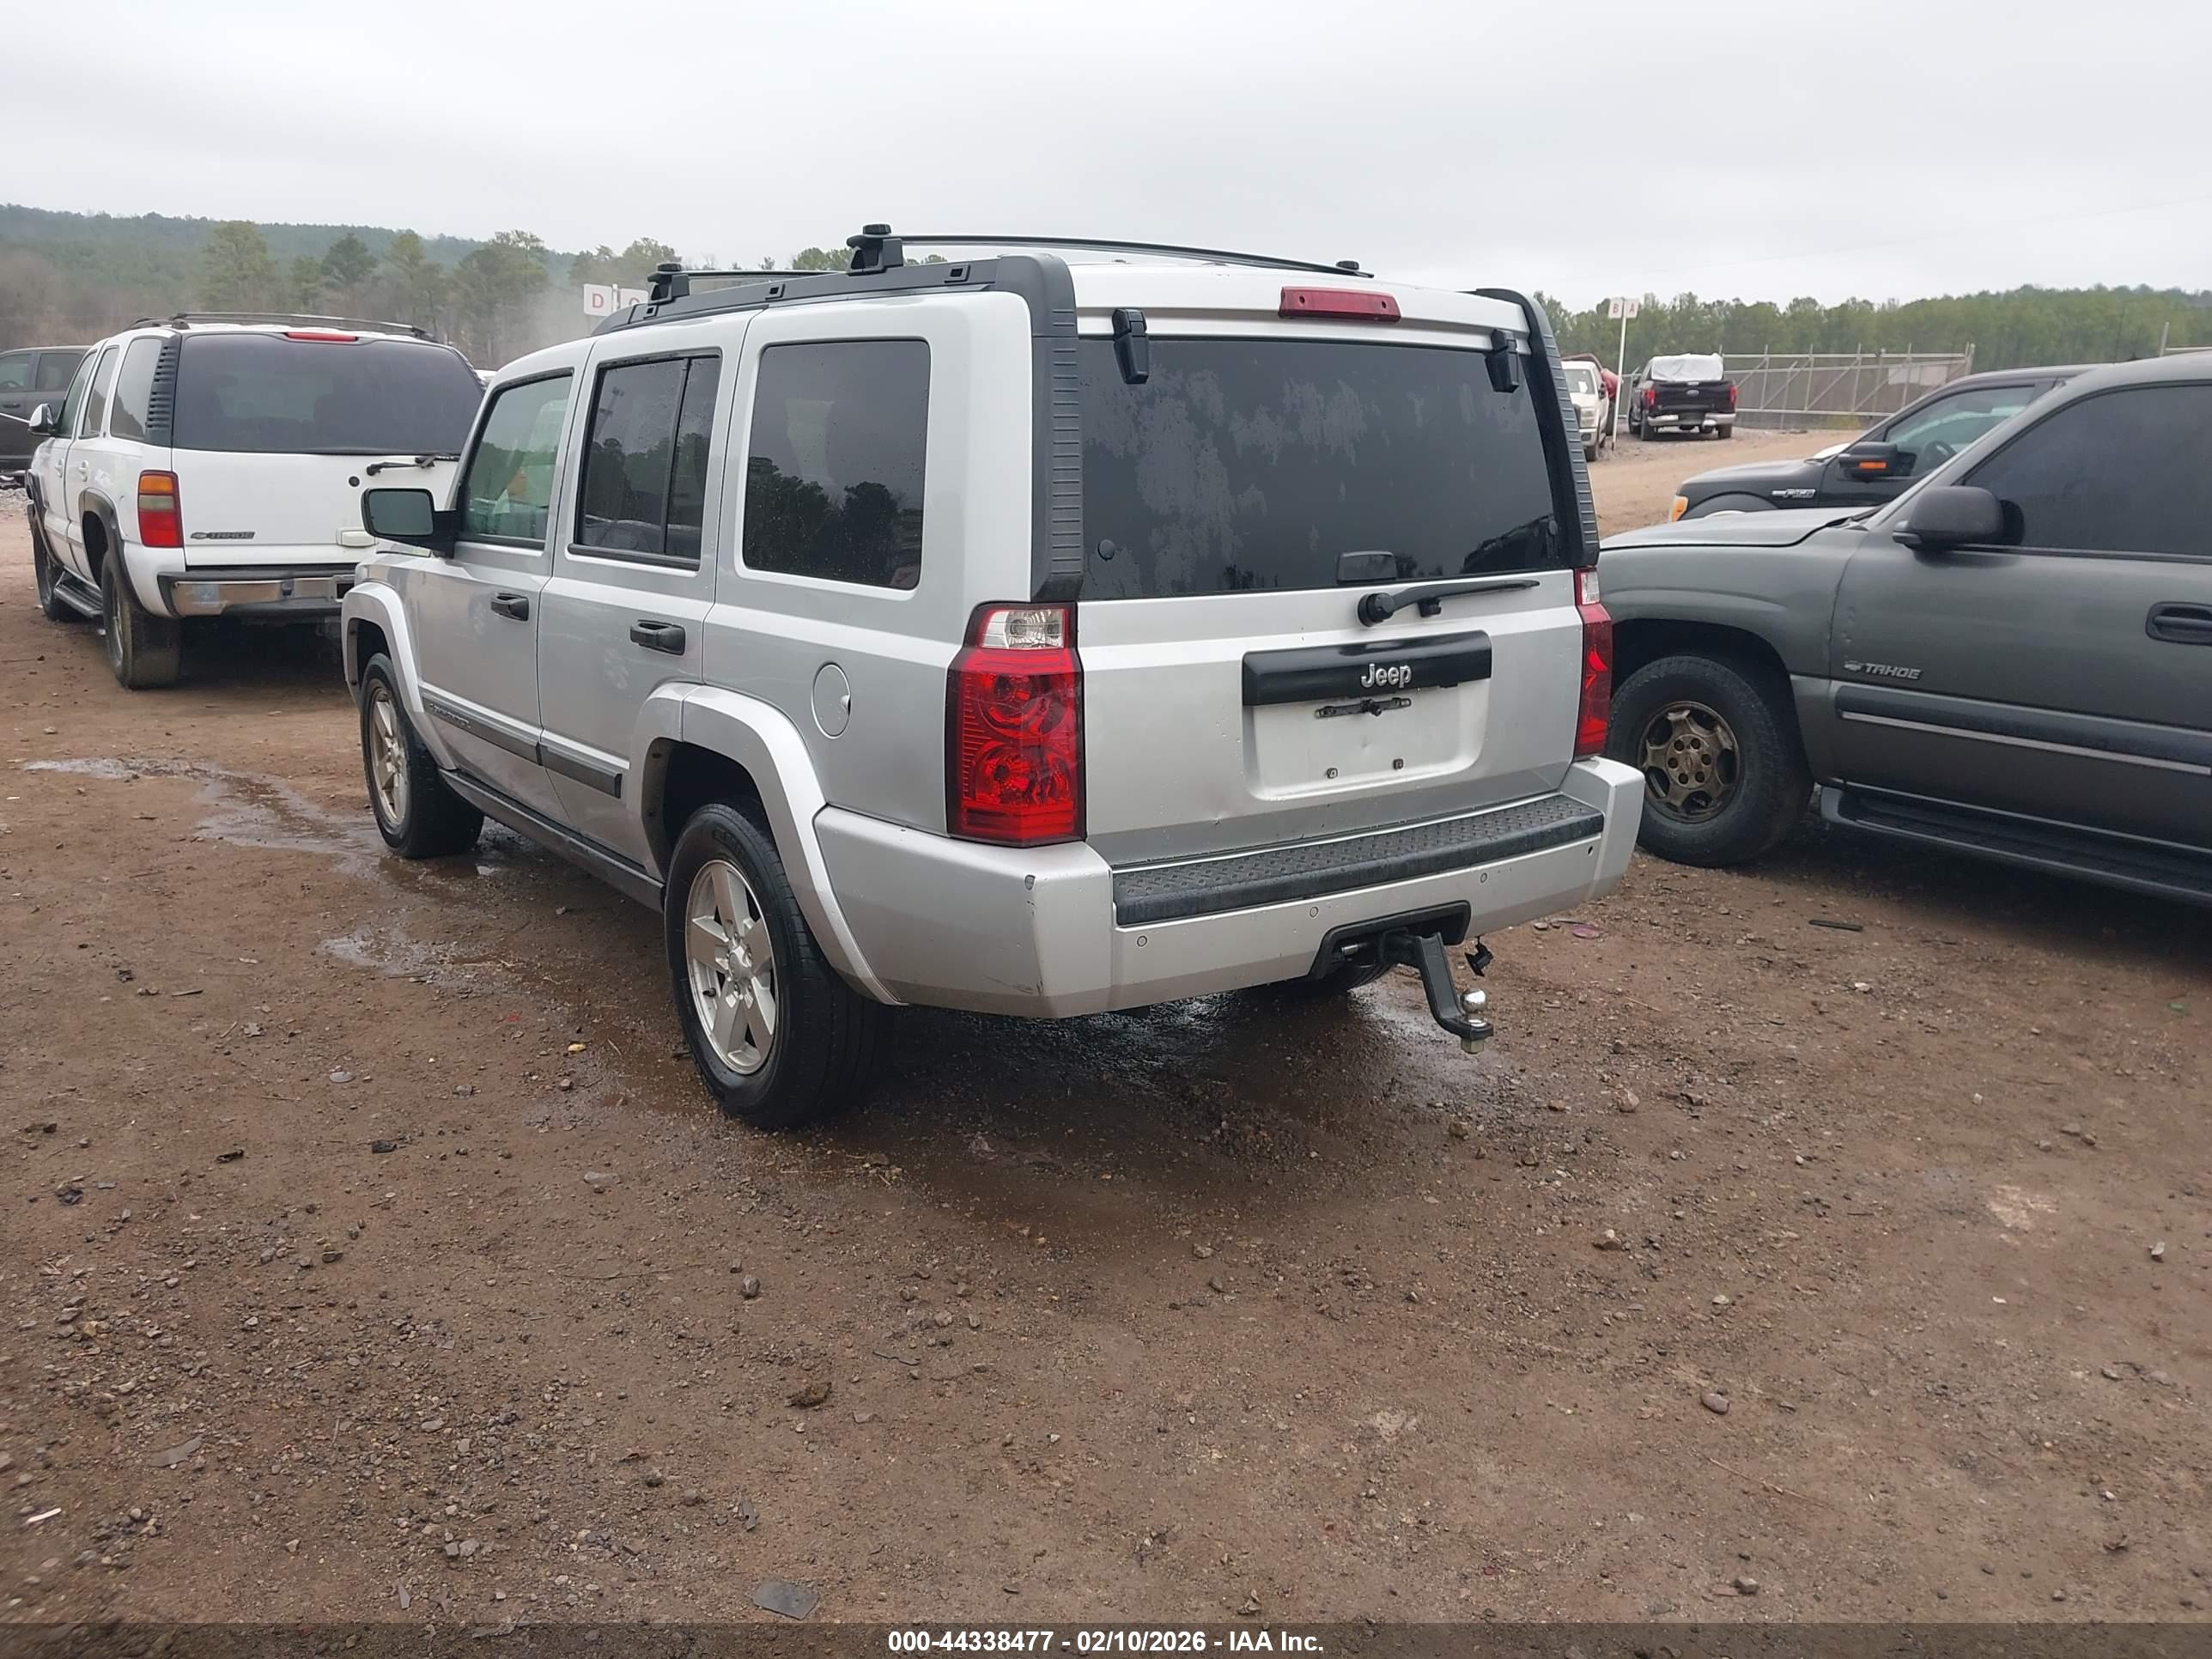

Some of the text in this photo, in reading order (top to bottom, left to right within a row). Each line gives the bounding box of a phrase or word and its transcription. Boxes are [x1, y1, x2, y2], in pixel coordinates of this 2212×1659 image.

[592, 293, 605, 309] D
[1613, 303, 1620, 314] B
[1628, 301, 1636, 314] A
[1360, 663, 1413, 689] Jeep
[1866, 662, 1921, 680] TAHOE
